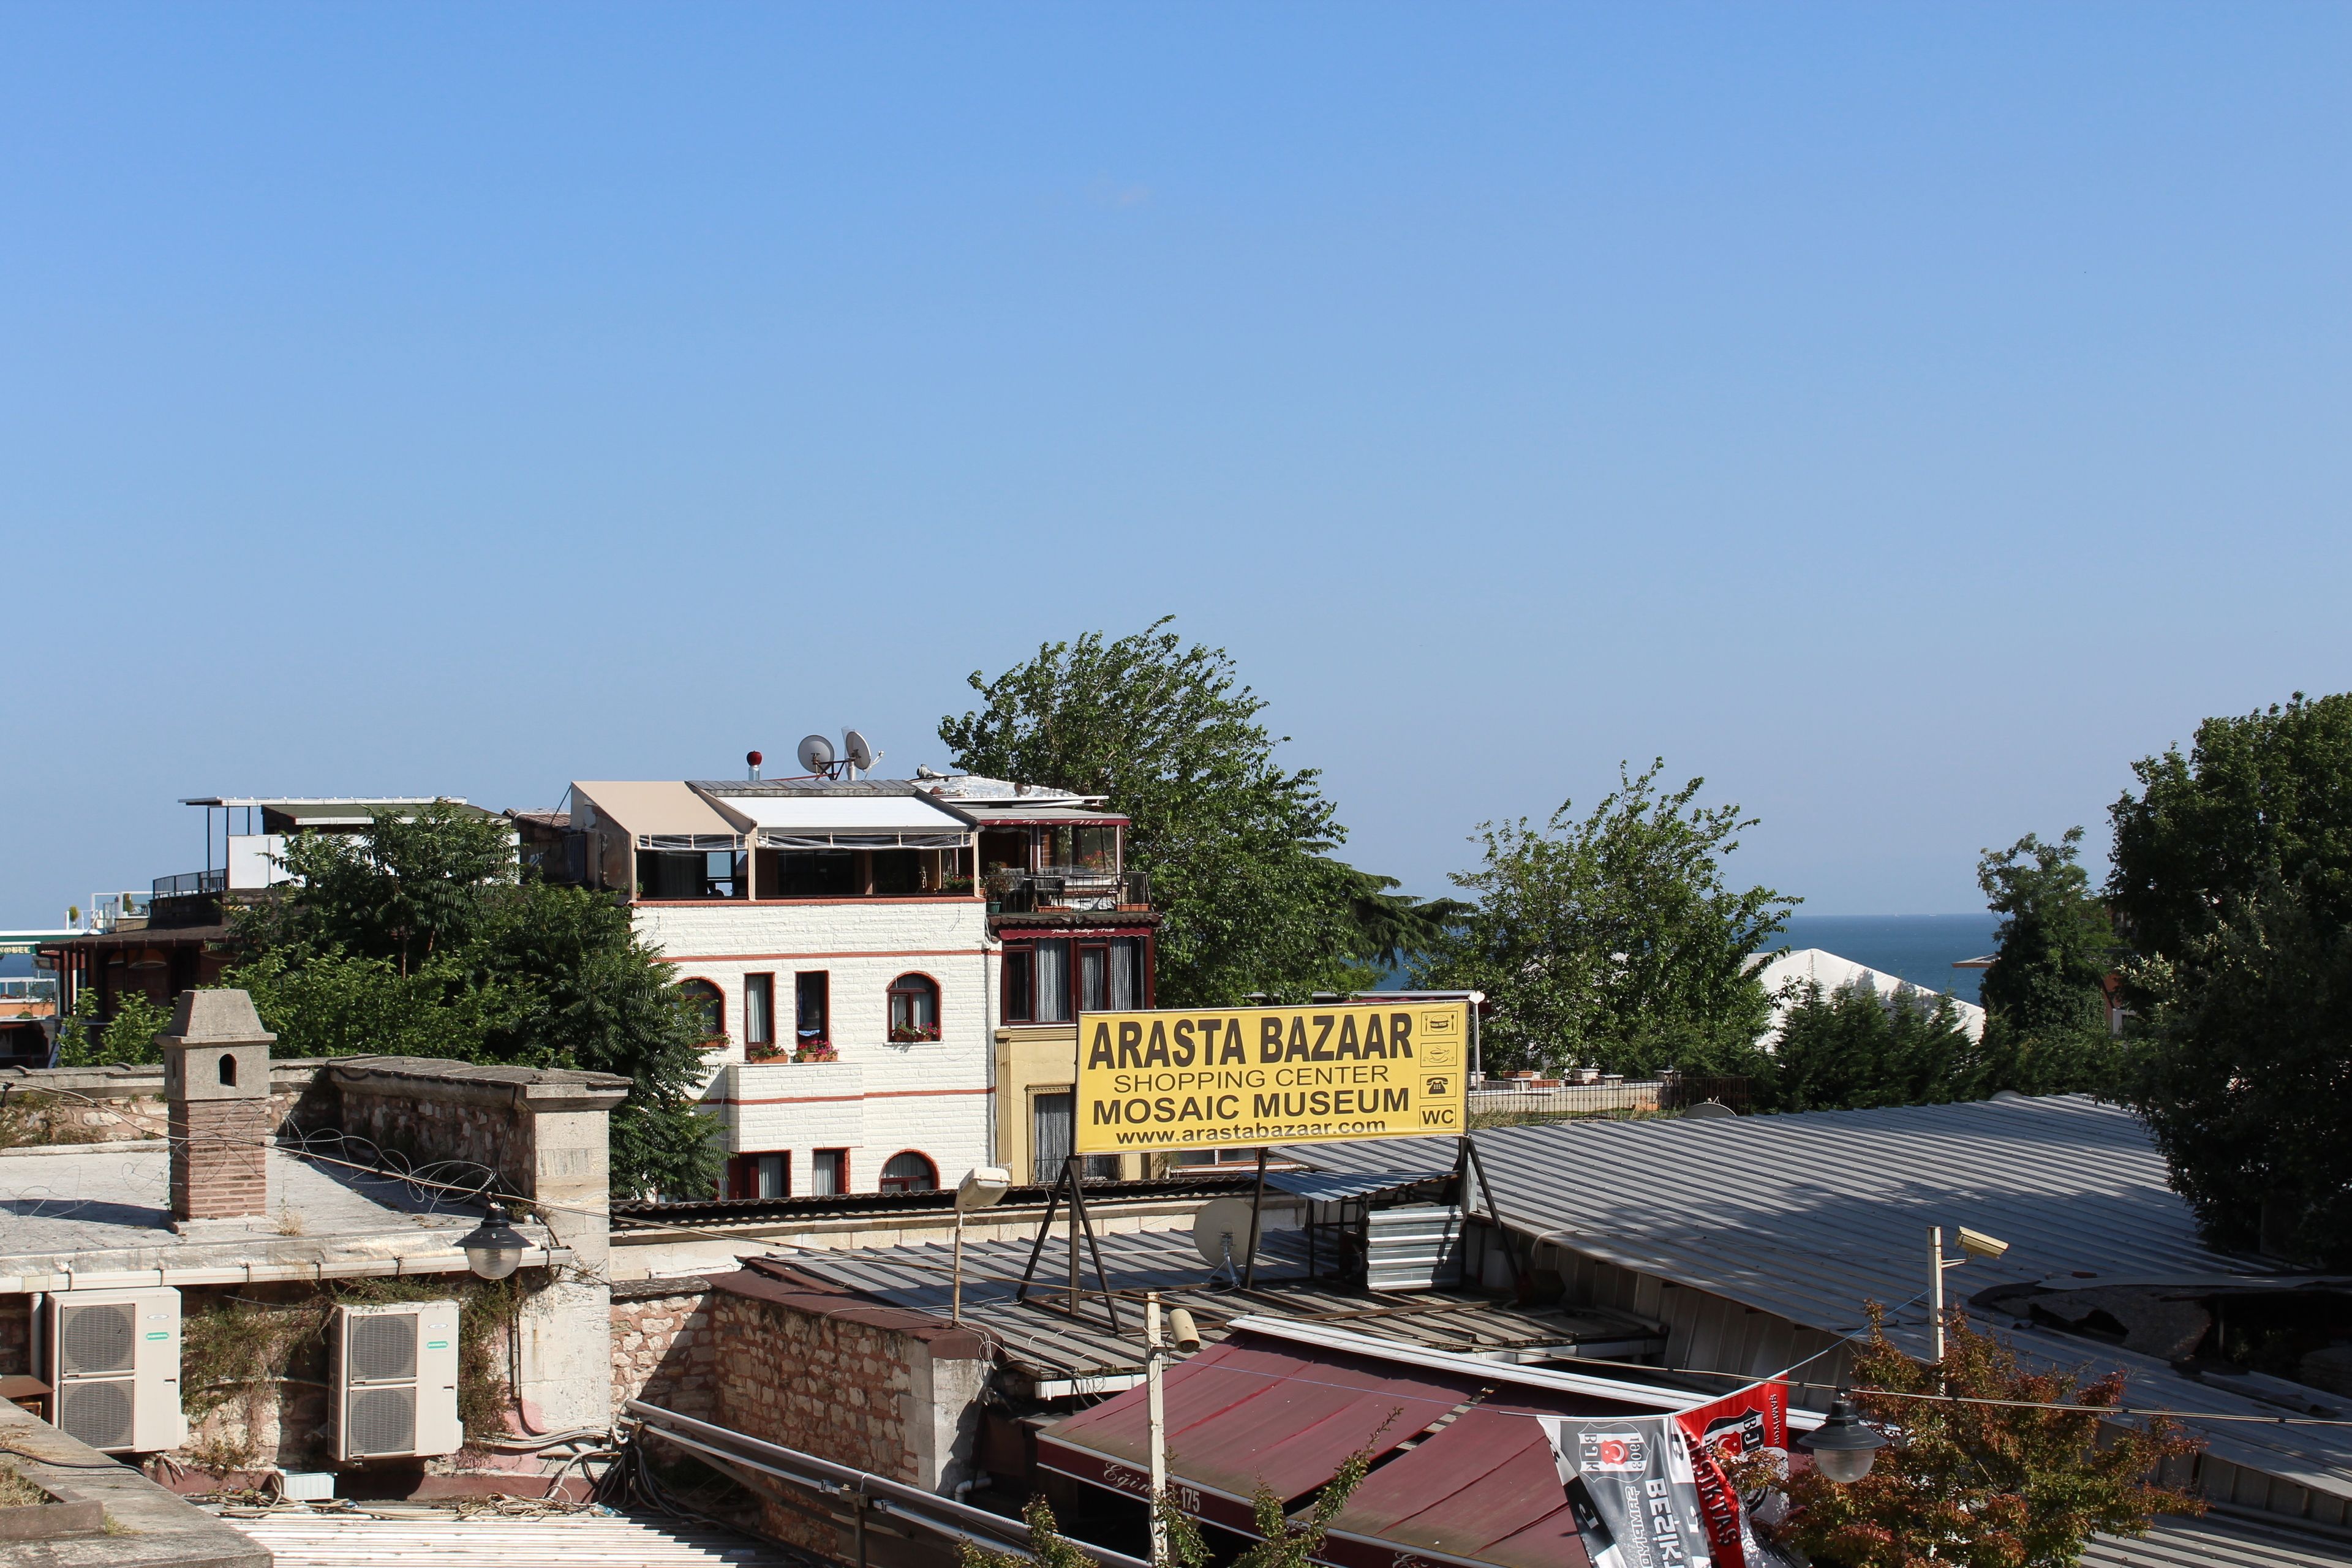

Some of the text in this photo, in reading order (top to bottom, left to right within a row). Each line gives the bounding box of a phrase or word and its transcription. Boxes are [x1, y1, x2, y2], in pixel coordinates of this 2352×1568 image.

[1088, 1013, 1413, 1069] ARASTA BAZAAR
[1114, 1065, 1389, 1093] SHOPPING CENTER
[1093, 1088, 1409, 1125] MOSAIC MUSEUM
[1422, 1109, 1454, 1125] WC
[1116, 1120, 1386, 1144] www.arastabazaar.com
[1181, 1487, 1200, 1513] 175
